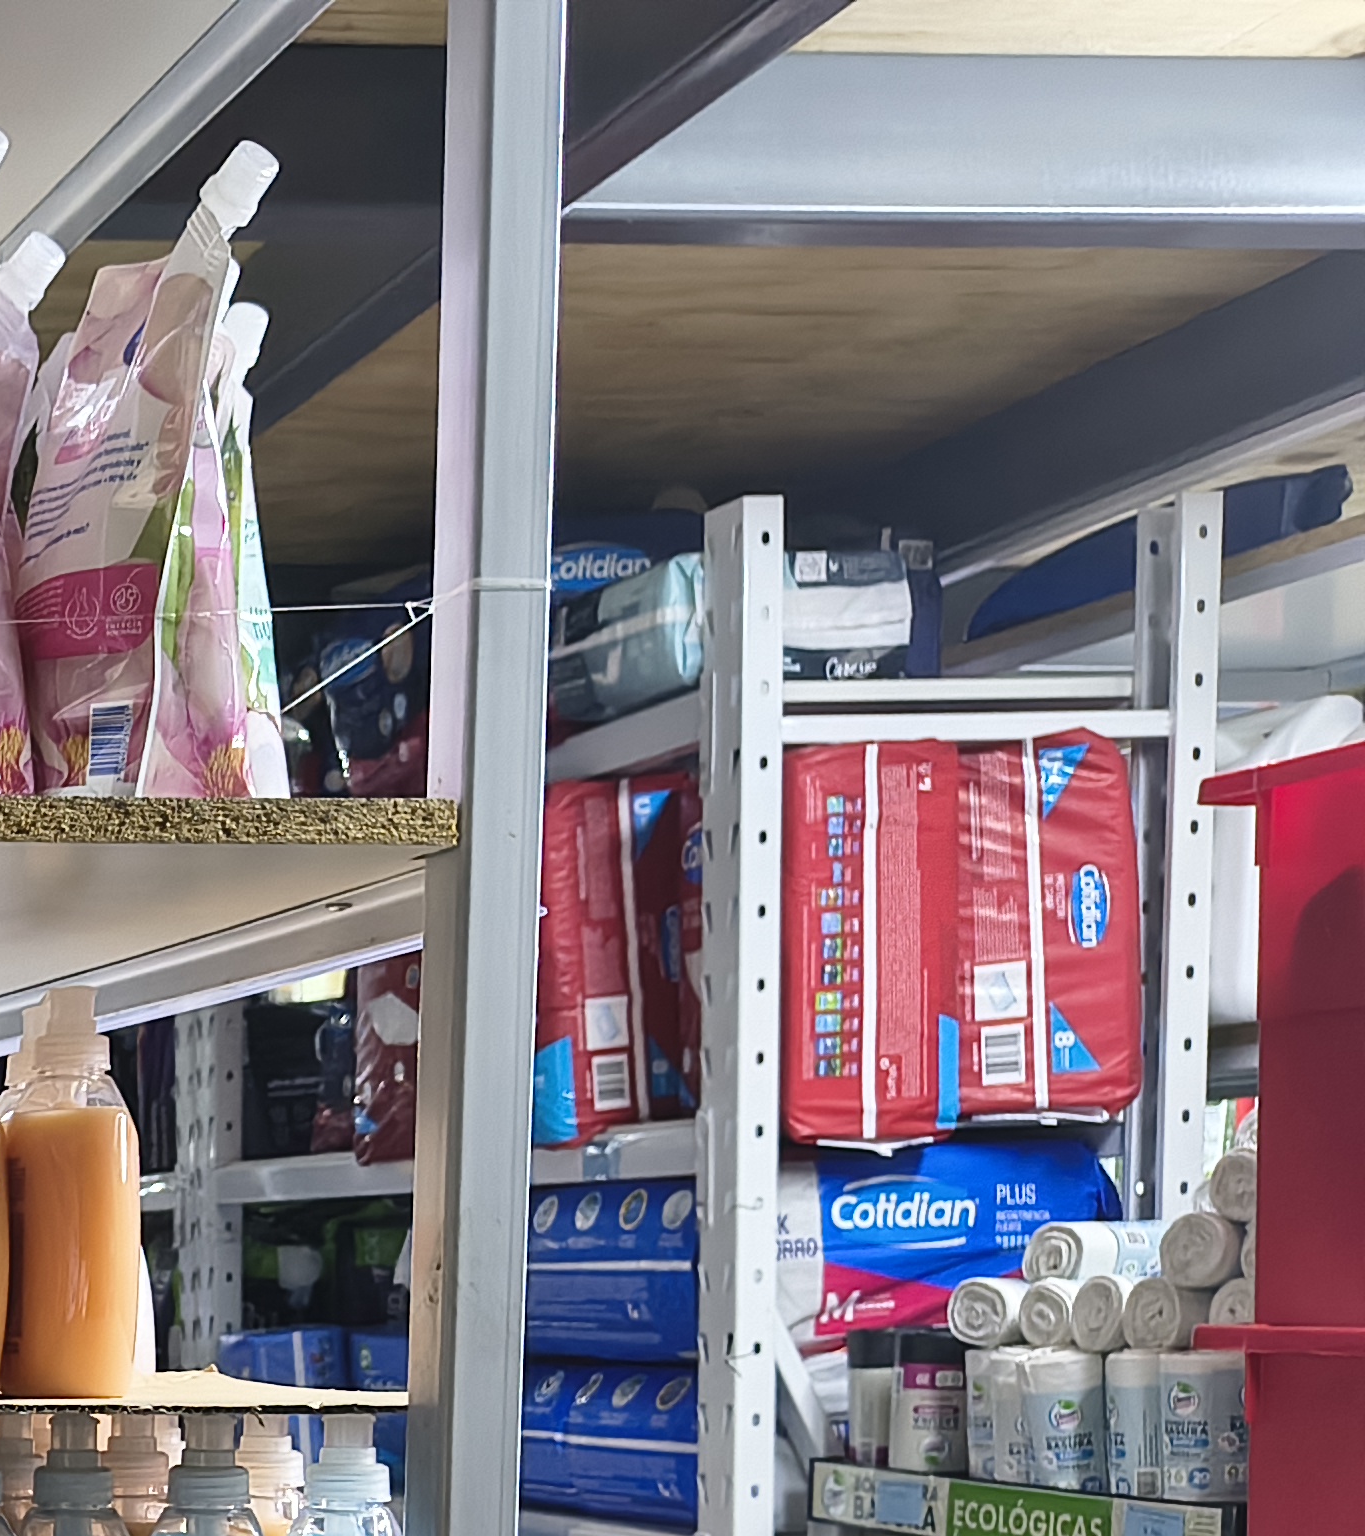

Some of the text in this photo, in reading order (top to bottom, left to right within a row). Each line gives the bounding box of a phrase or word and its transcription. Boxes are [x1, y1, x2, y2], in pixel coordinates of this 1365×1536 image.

[1078, 863, 1100, 949] Cotidian
[830, 1183, 1036, 1231] Cotidian PLUS
